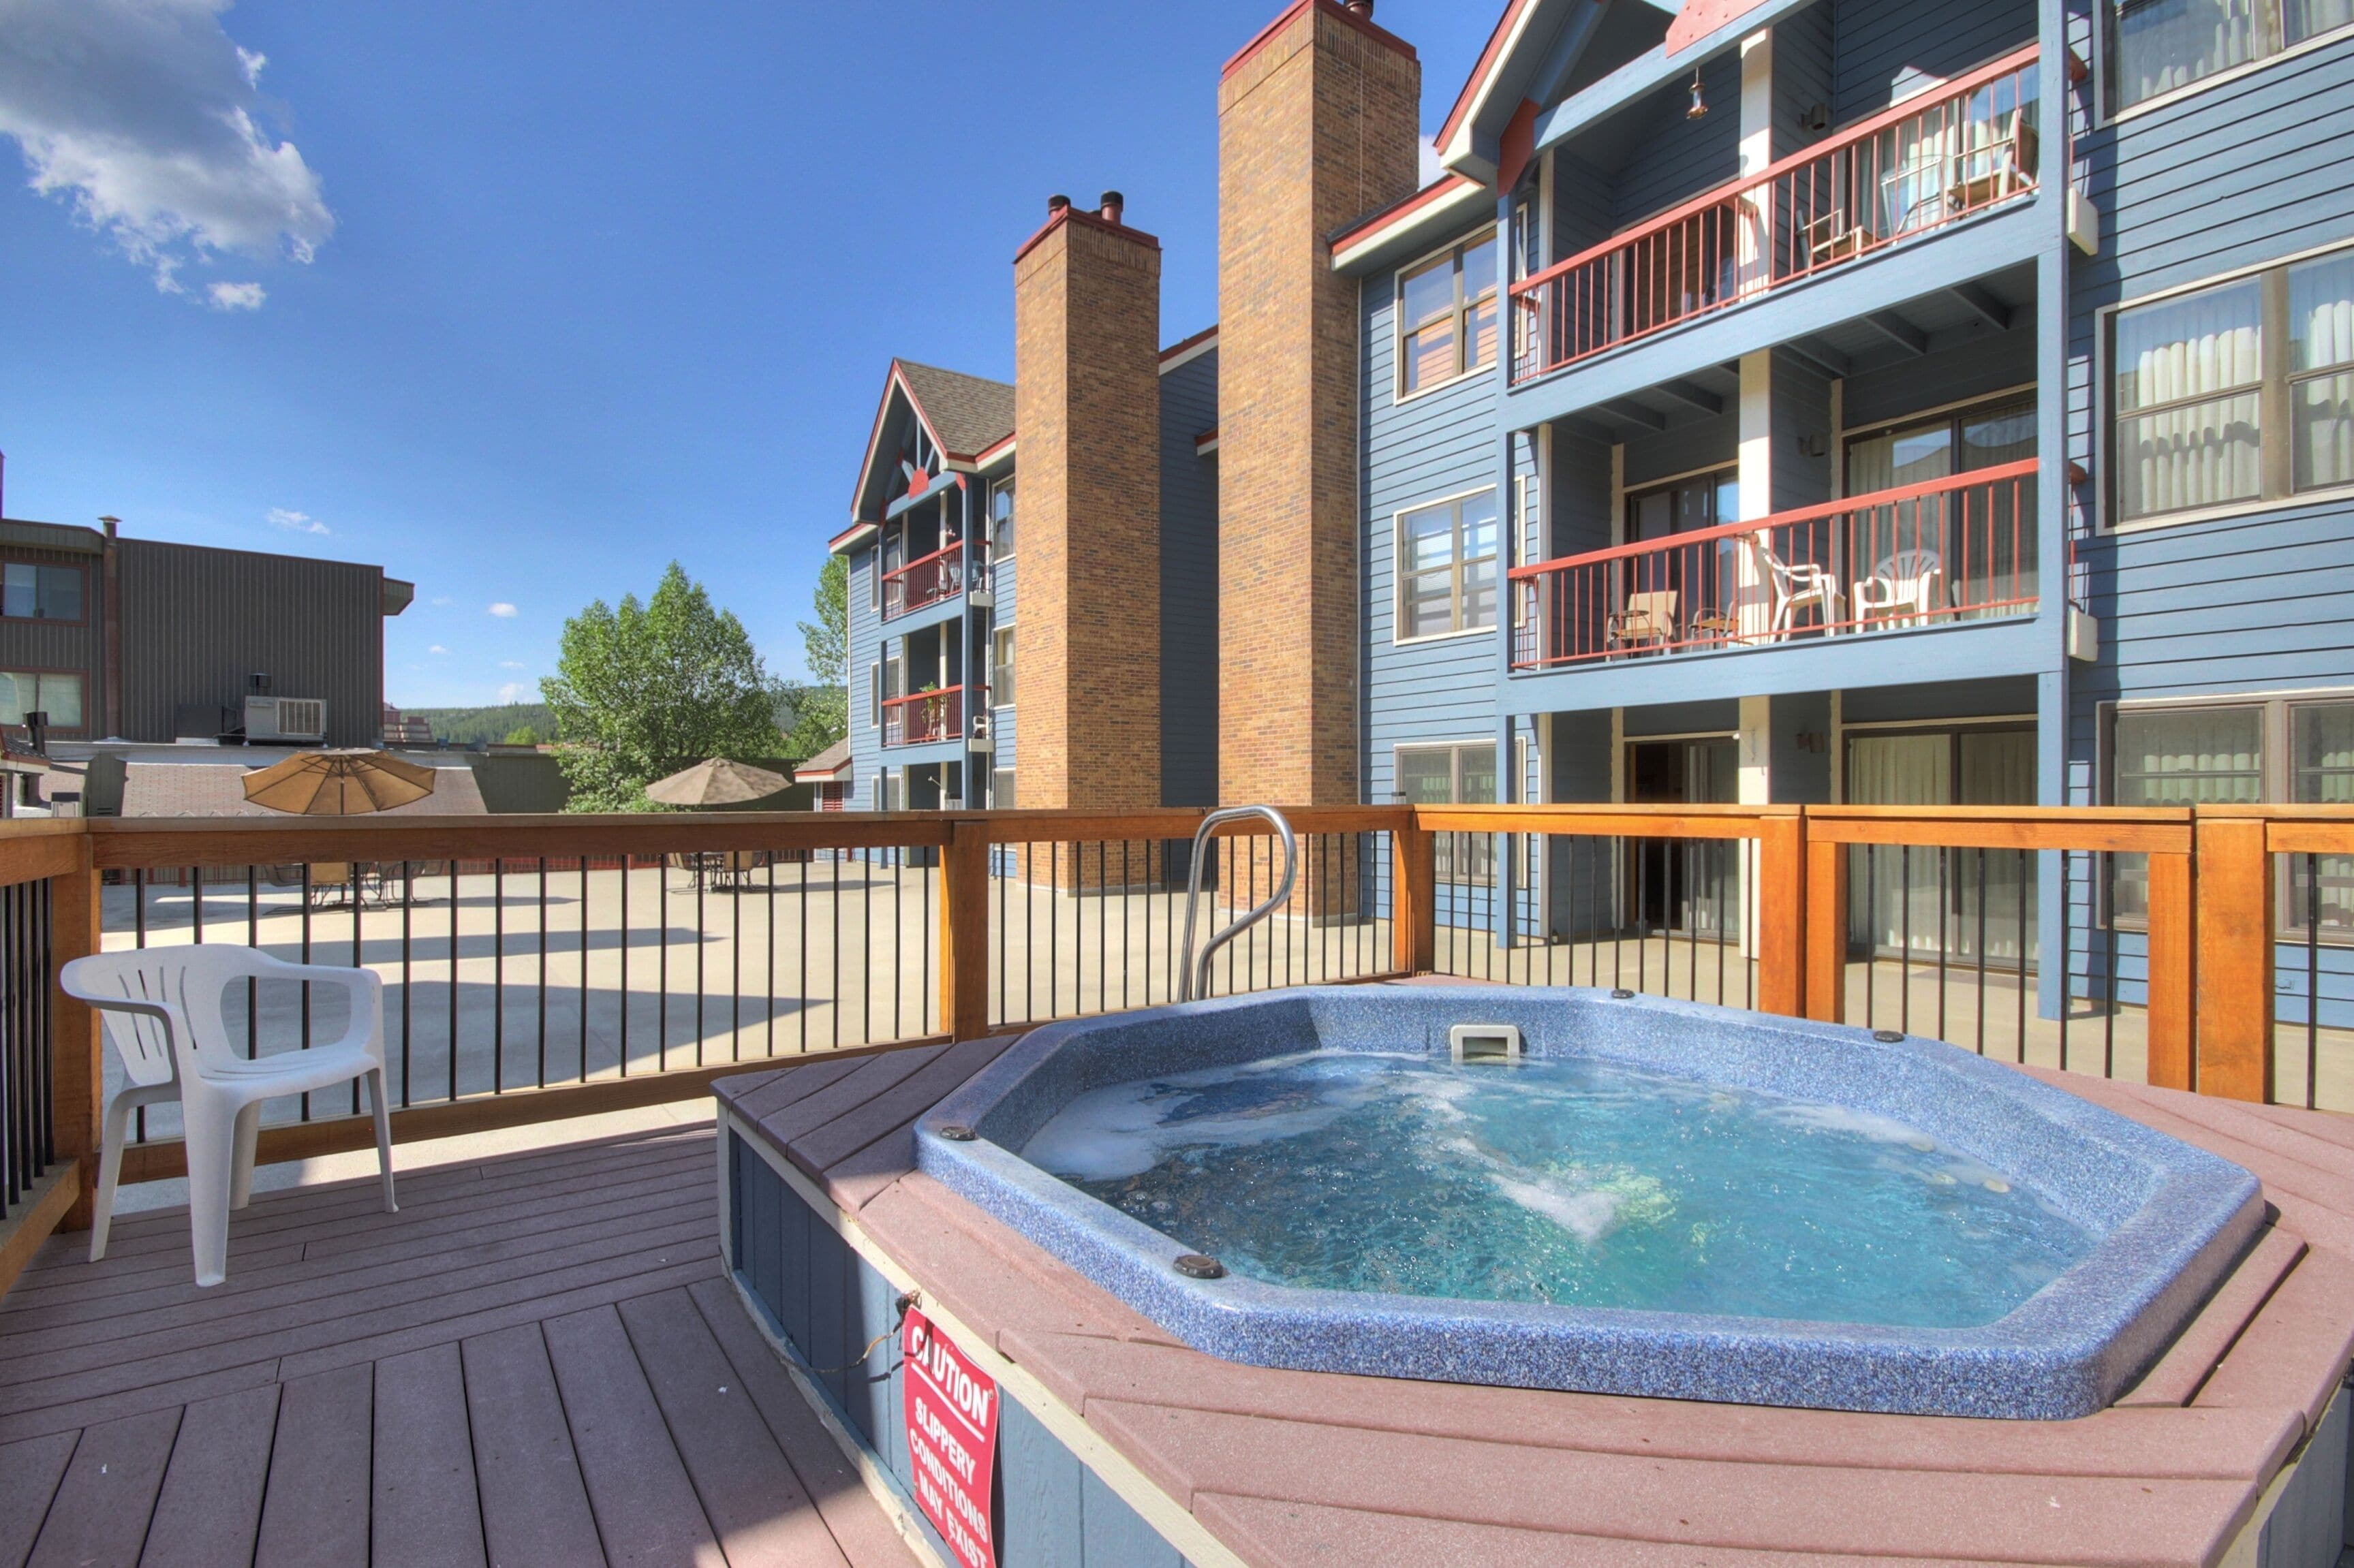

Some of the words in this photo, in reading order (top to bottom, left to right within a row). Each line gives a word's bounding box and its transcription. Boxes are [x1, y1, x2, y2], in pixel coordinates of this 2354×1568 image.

[912, 1326, 988, 1428] CAUTION
[910, 1428, 988, 1543] CONDITIONS
[915, 1396, 976, 1485] SLIPPERY
[918, 1469, 942, 1520] MAY
[946, 1506, 987, 1568] EXIST
